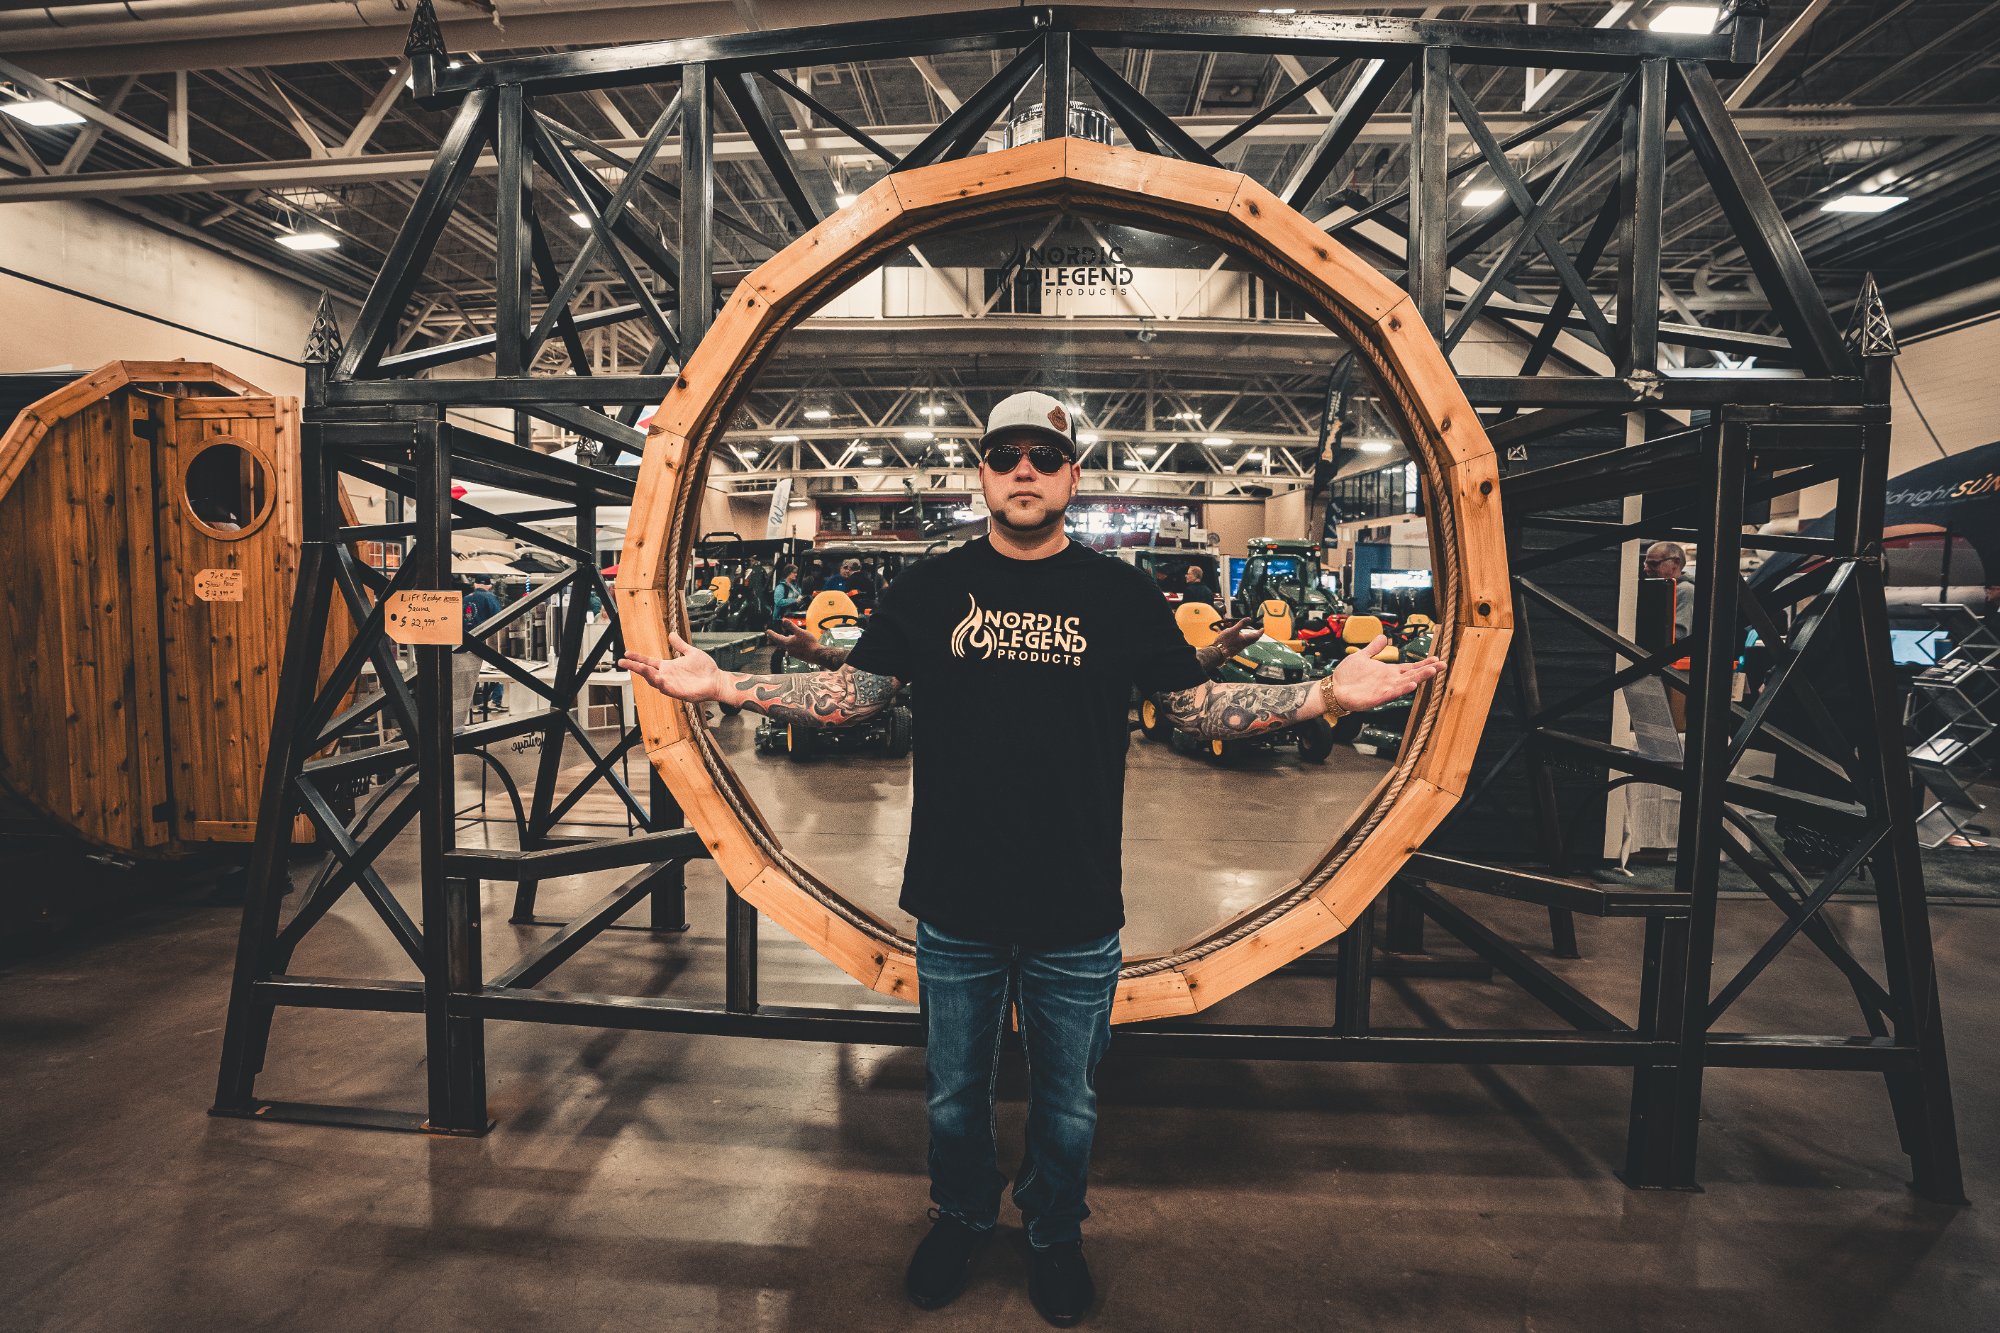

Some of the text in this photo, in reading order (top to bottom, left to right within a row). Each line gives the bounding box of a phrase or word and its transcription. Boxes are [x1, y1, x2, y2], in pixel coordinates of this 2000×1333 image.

[1029, 247, 1124, 265] NORDIC
[1045, 267, 1134, 286] LEGEND
[1045, 288, 1128, 296] PRODUCTS
[408, 603, 430, 612] Sauna
[984, 610, 1080, 635] NORDIC
[998, 629, 1087, 653] LEGEND
[997, 649, 1081, 667] PRODUCTS
